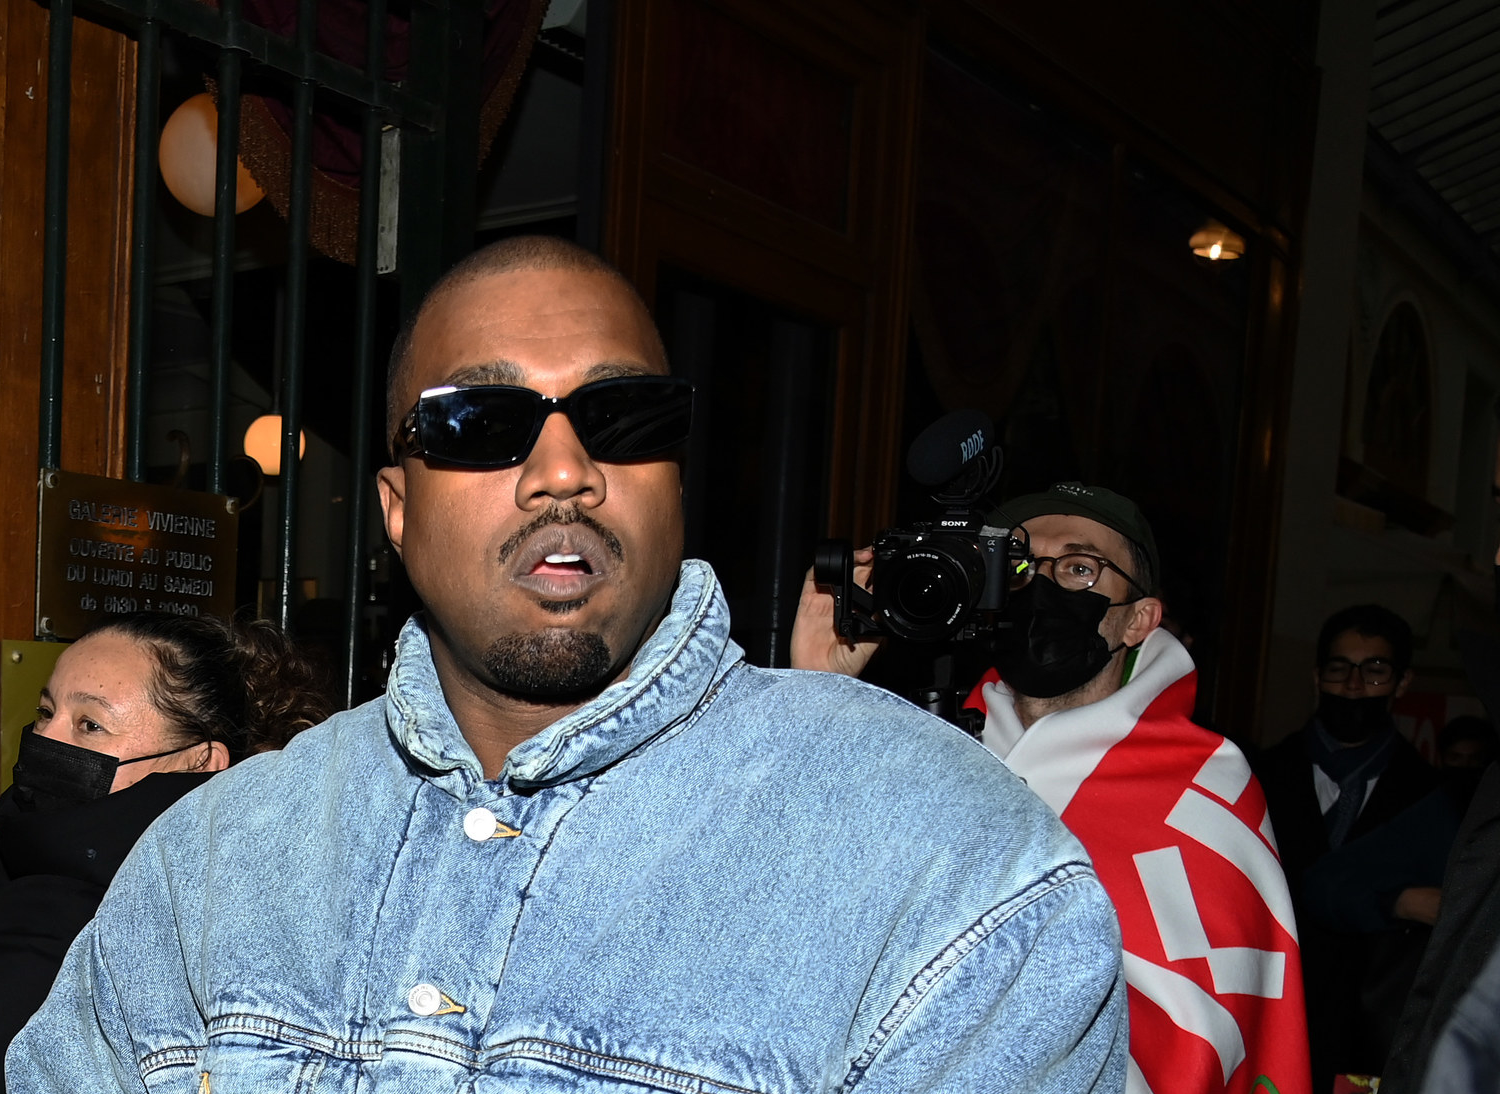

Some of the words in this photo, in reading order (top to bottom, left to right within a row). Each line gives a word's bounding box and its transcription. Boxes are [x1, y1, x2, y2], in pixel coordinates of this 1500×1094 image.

[68, 500, 138, 528] GALERIE
[146, 510, 216, 539] VIVIENNE
[69, 537, 134, 563] OUVERTE
[140, 547, 159, 565] AU
[165, 550, 213, 572] PUBLIC
[66, 564, 86, 582] DU
[93, 568, 133, 589] LUNDI
[139, 573, 157, 591] AU
[164, 575, 214, 597] SAMEDI
[80, 593, 97, 611] de
[103, 597, 138, 614] 8h30
